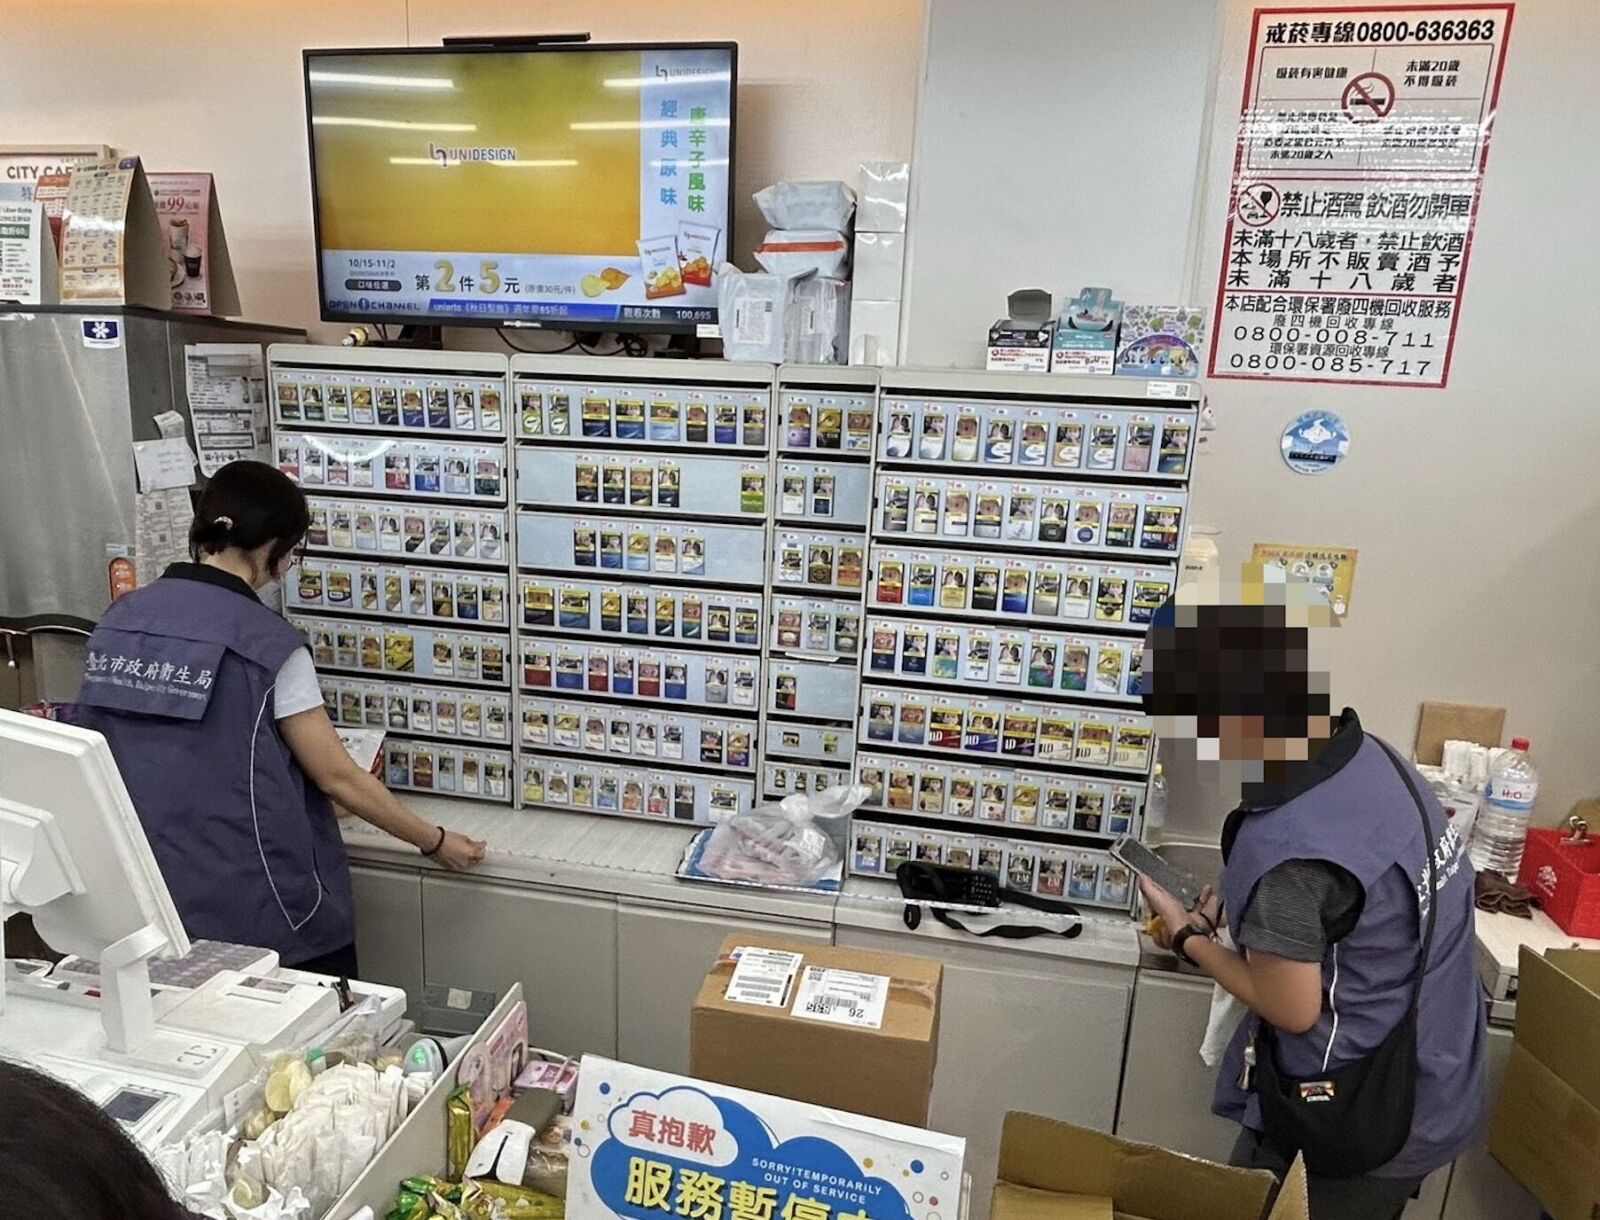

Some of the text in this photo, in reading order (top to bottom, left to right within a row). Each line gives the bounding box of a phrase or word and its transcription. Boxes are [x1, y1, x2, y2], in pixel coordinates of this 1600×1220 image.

[1265, 20, 1495, 44] 戒菸專線0800-636363
[1276, 67, 1348, 79] 吸菸有害健康
[1406, 60, 1460, 73] 未滿20歲
[1404, 75, 1459, 88] 不得吸菸
[449, 149, 516, 161] UNIDESIGN
[6, 166, 39, 179] CITY
[349, 259, 396, 269] 10/15-11/2
[1228, 268, 1458, 293] 未滿十八歲者
[1234, 326, 1434, 348] 0800-008-711
[1230, 354, 1431, 376] 0800-085-717
[628, 1109, 716, 1157] 真抱歉
[752, 1157, 882, 1196] SORRY!TEMPORARILY
[625, 1157, 872, 1220] 服務暫停
[764, 1172, 866, 1205] OUT OF SERVICE
